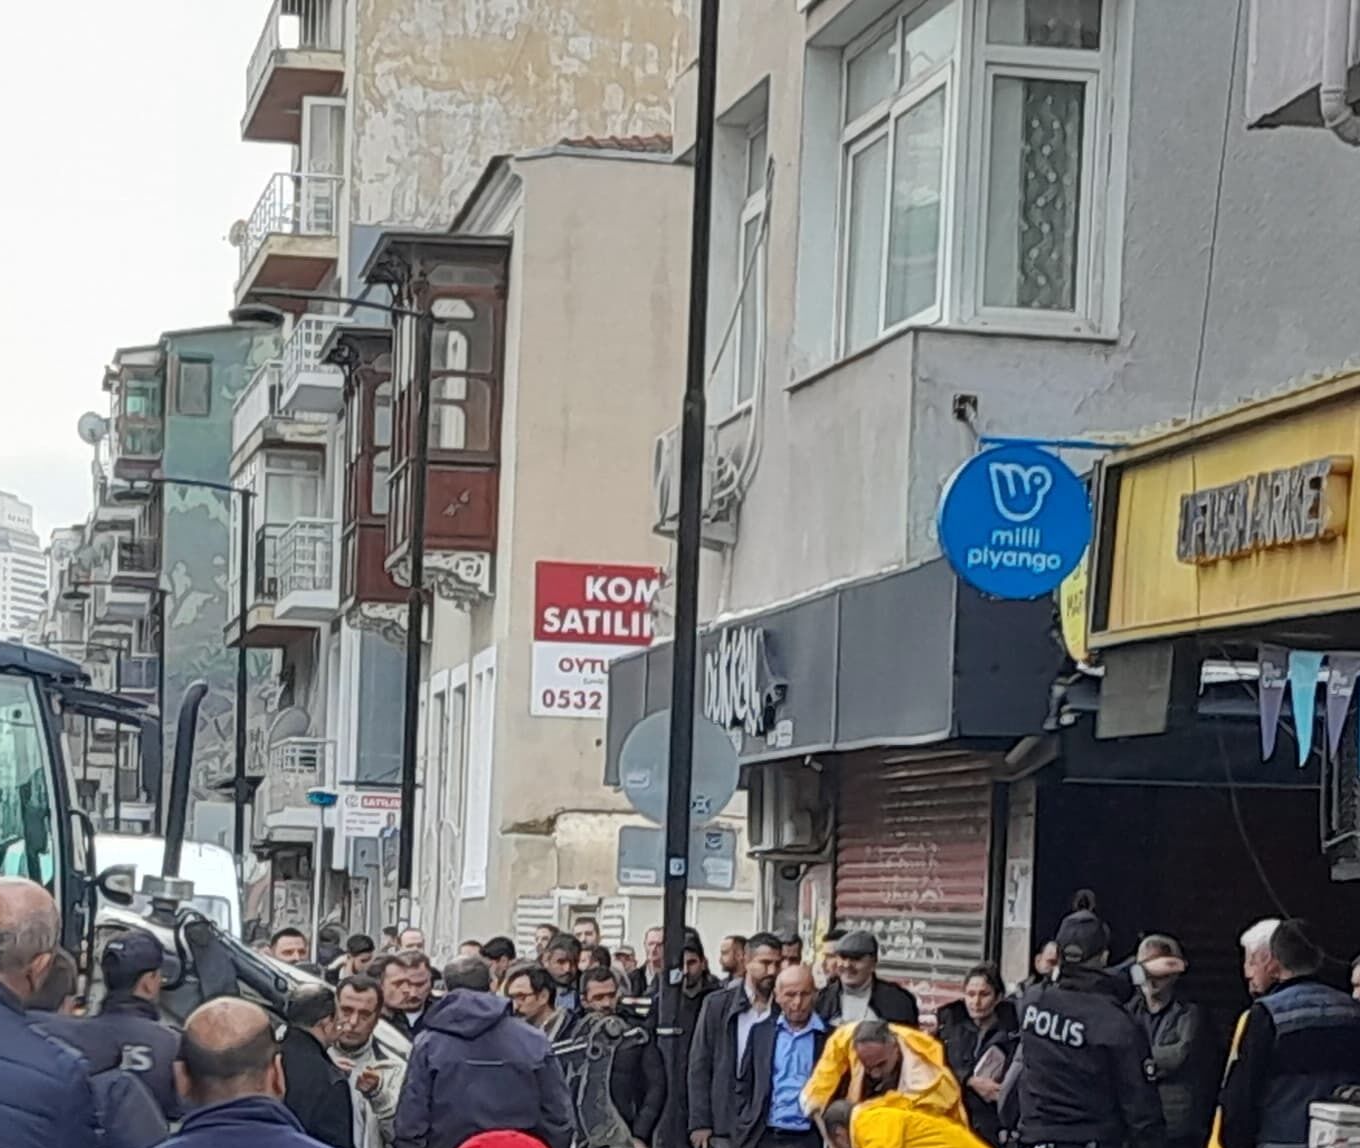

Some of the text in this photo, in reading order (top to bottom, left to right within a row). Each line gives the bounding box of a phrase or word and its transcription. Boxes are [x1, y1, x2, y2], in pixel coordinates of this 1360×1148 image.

[992, 527, 1040, 548] milli
[967, 546, 1062, 574] piyango
[542, 689, 603, 710] 0532
